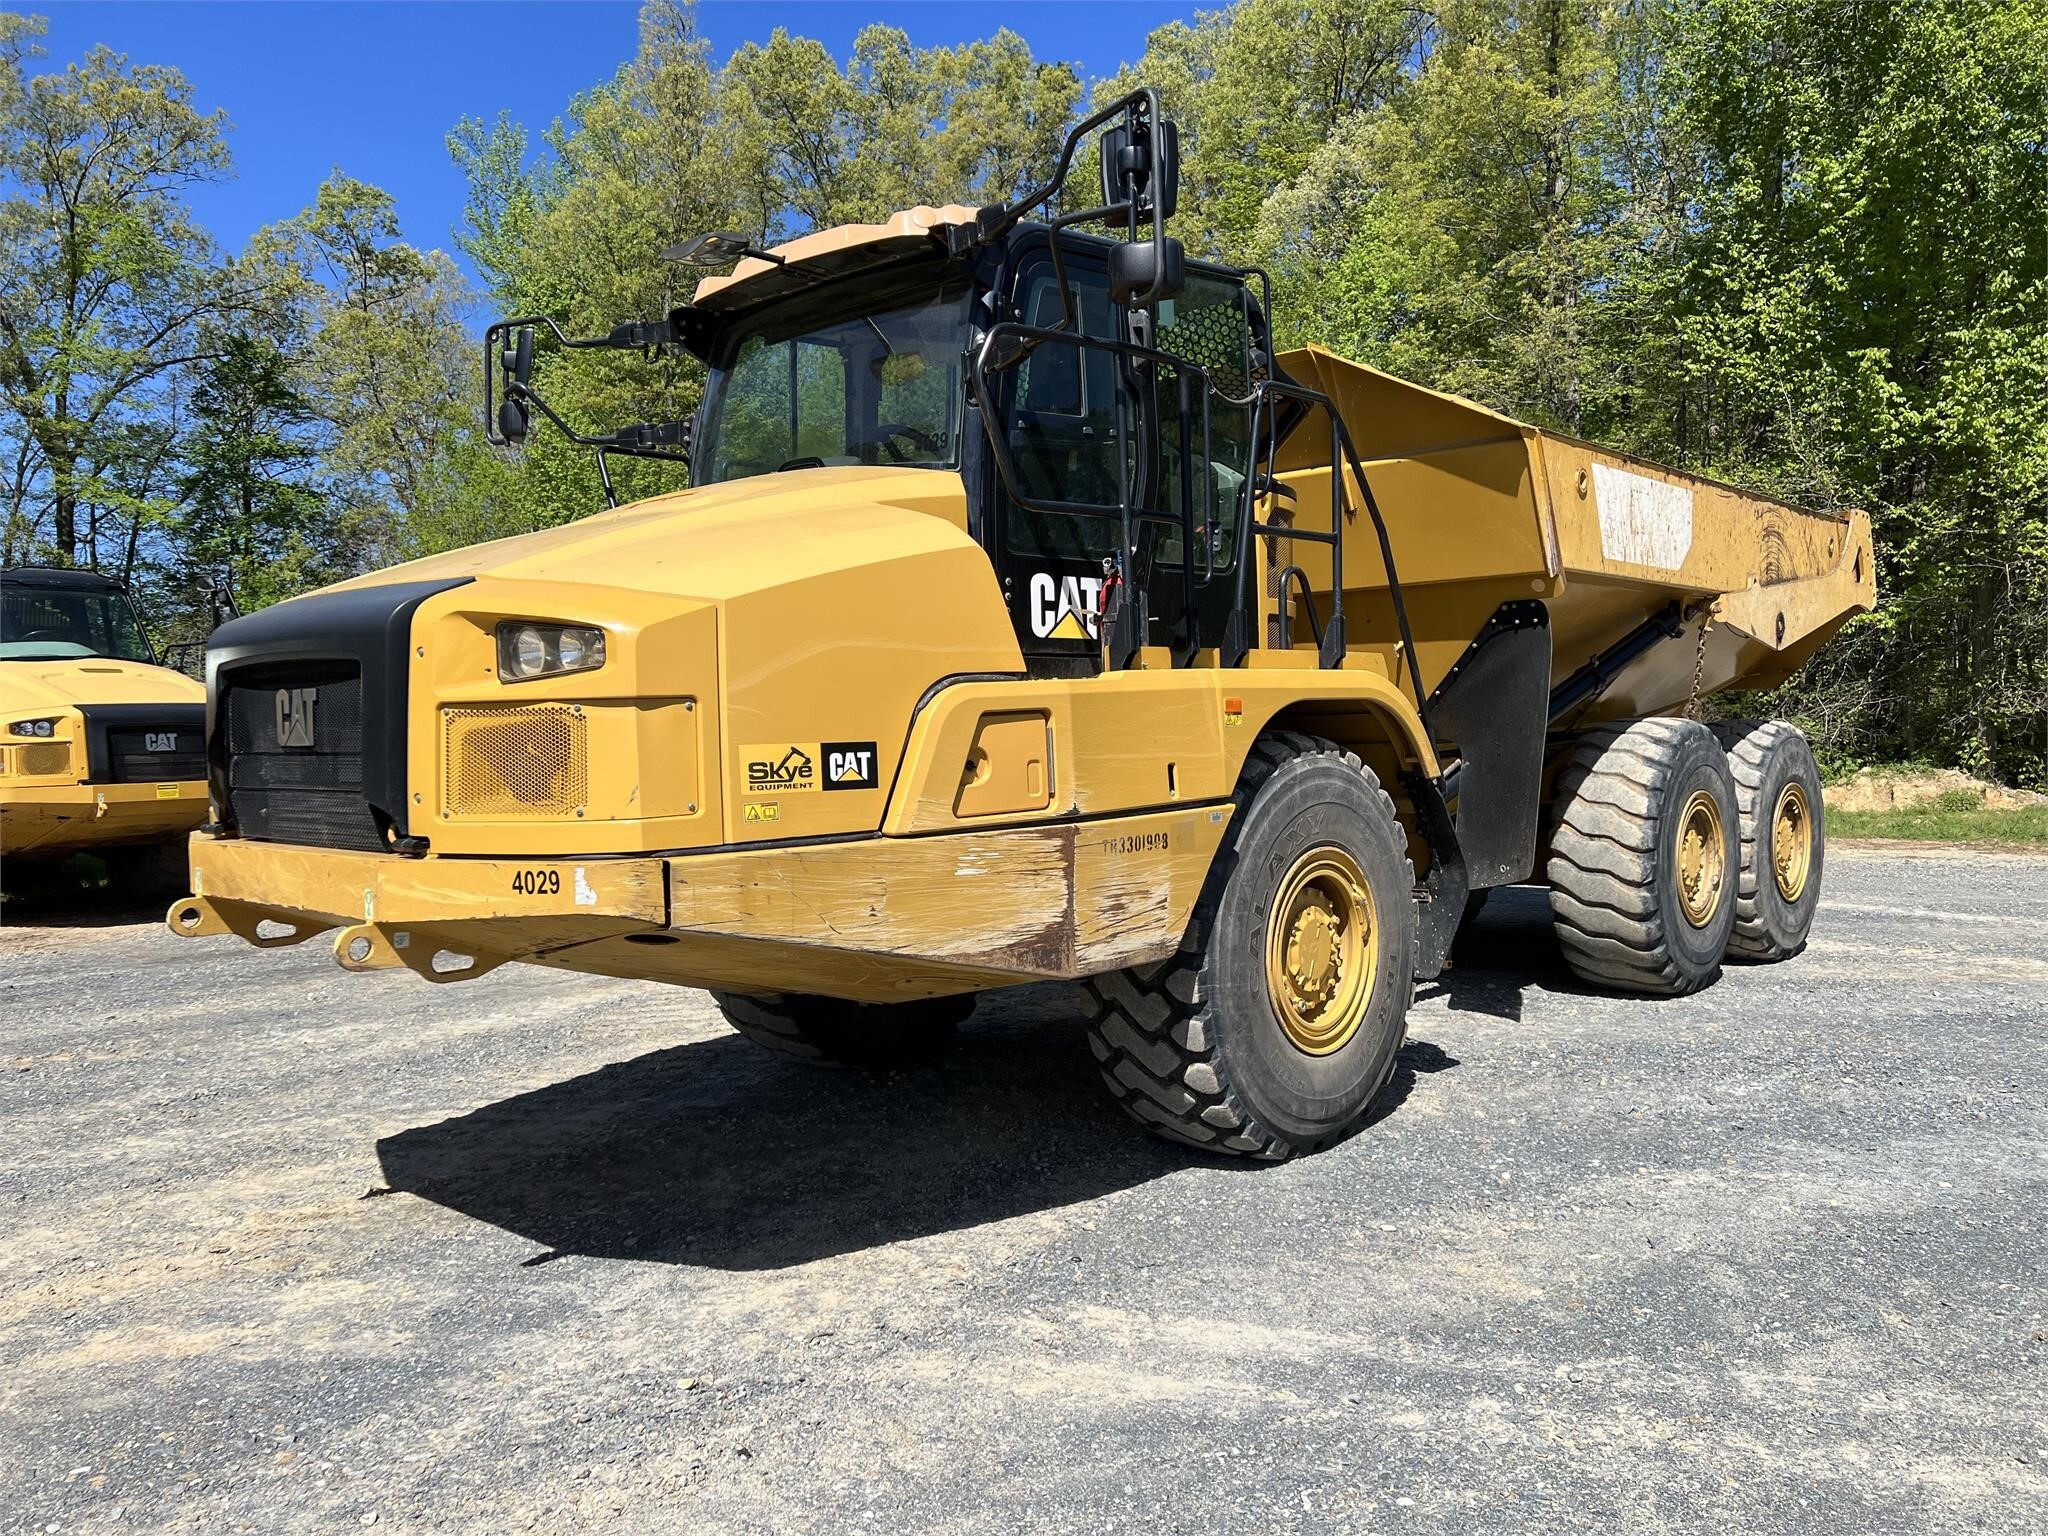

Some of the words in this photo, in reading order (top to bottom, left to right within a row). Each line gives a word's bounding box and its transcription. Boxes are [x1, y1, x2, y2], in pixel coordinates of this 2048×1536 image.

[1030, 573, 1103, 640] CAT
[276, 688, 316, 746] CAT
[145, 733, 177, 751] CAT
[748, 760, 812, 784] Skye
[829, 751, 871, 782] CAT
[749, 782, 814, 791] EQUIPMENT
[512, 870, 560, 894] 4029
[1247, 808, 1328, 1003] GALAXY
